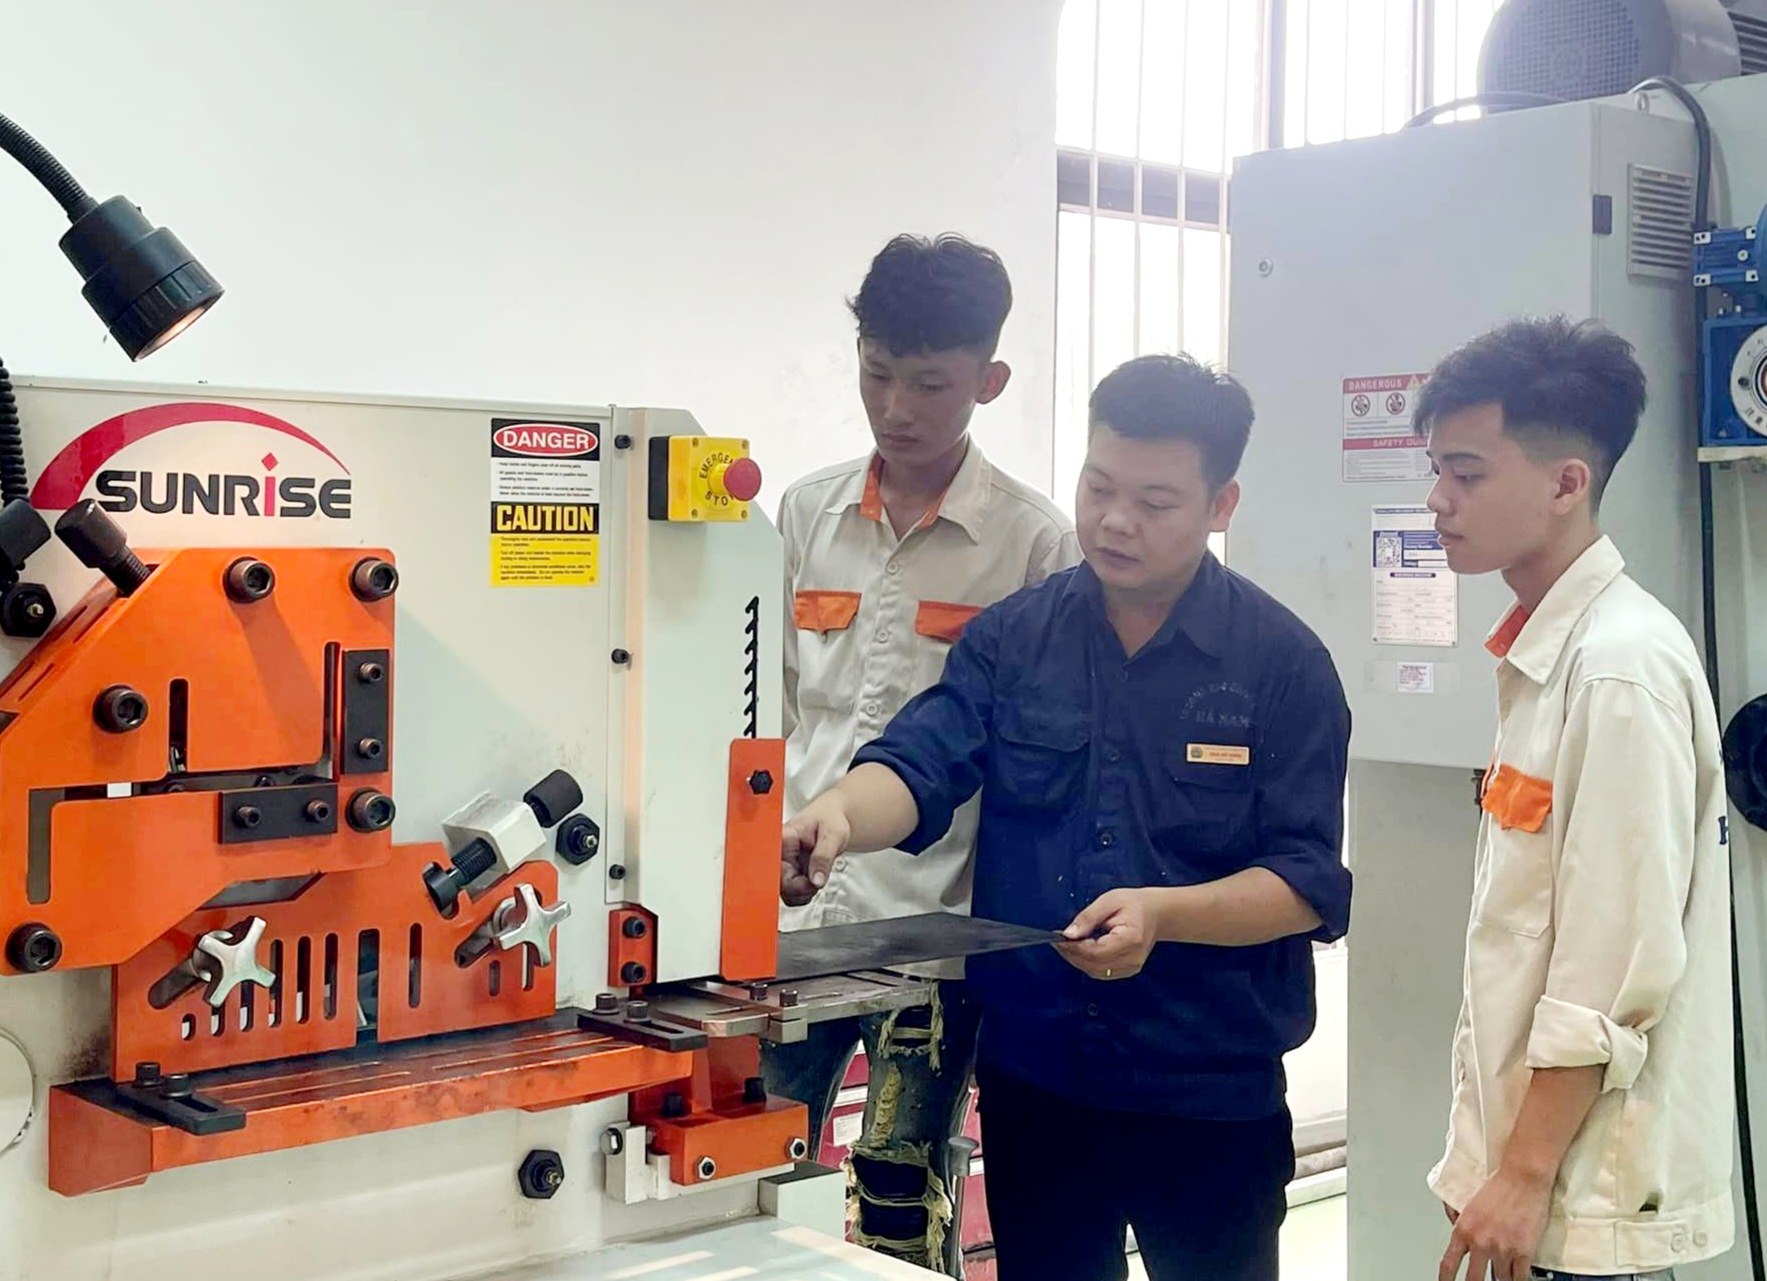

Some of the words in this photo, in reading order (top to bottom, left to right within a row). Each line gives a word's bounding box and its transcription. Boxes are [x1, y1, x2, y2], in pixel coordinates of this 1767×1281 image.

[1348, 378, 1402, 391] DANGEROUS
[503, 430, 590, 450] DANGER
[704, 490, 734, 506] STO
[497, 504, 594, 531] CAUTION
